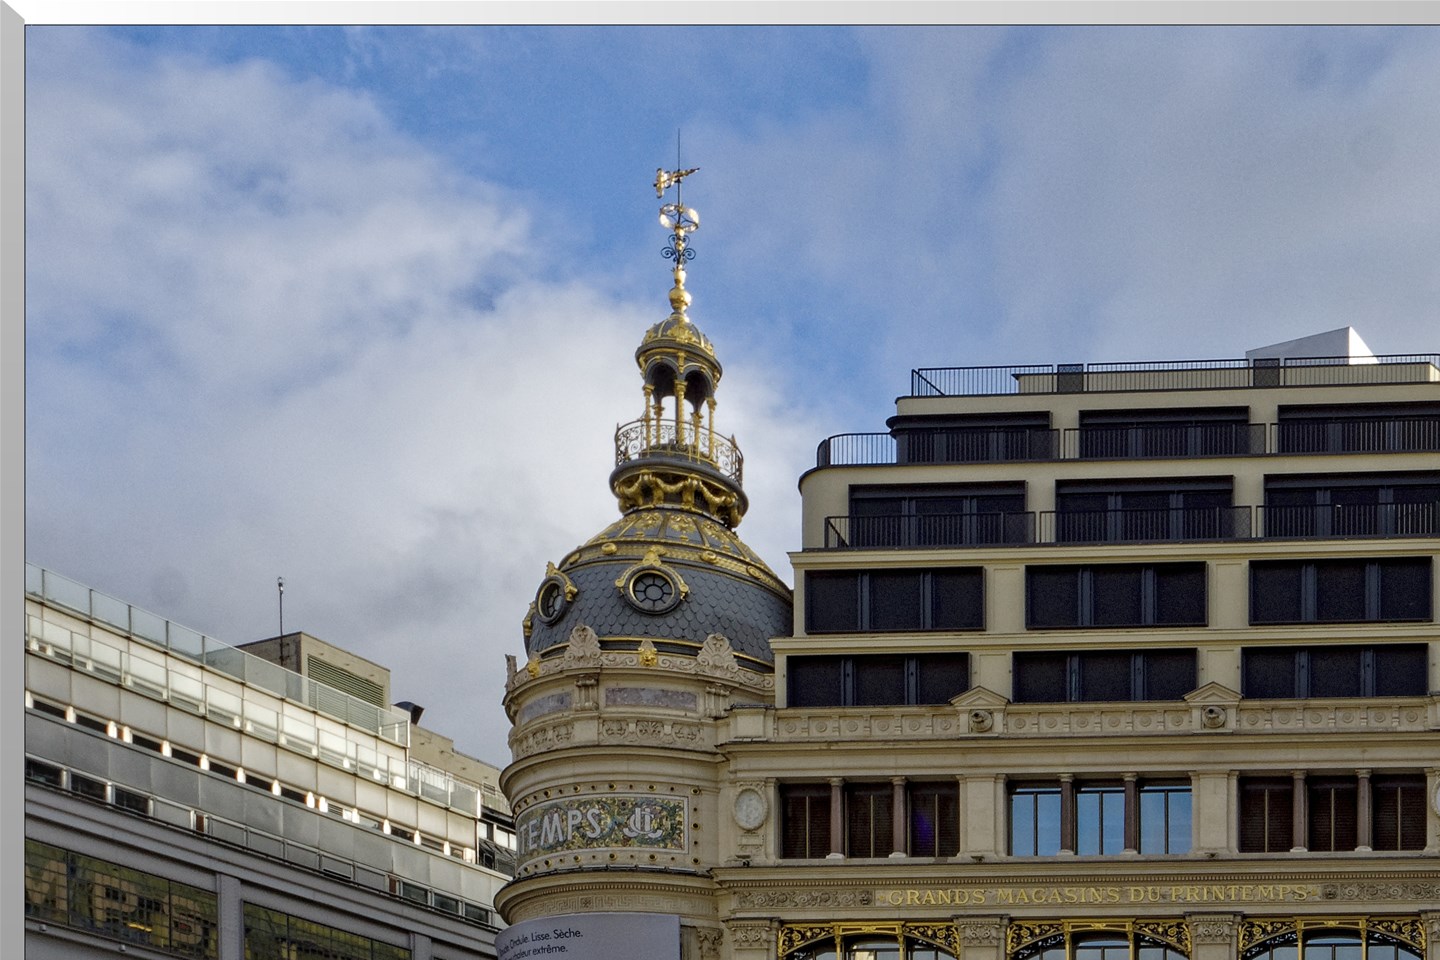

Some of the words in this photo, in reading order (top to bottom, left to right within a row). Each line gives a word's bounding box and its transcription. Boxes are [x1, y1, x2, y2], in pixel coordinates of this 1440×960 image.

[888, 888, 986, 905] GRANDS
[996, 887, 1120, 904] MAGASINS
[1130, 886, 1160, 902] DU
[1171, 884, 1309, 901] PRINTEMPS
[531, 931, 552, 942] Lisse.
[553, 928, 583, 940] Sèche.
